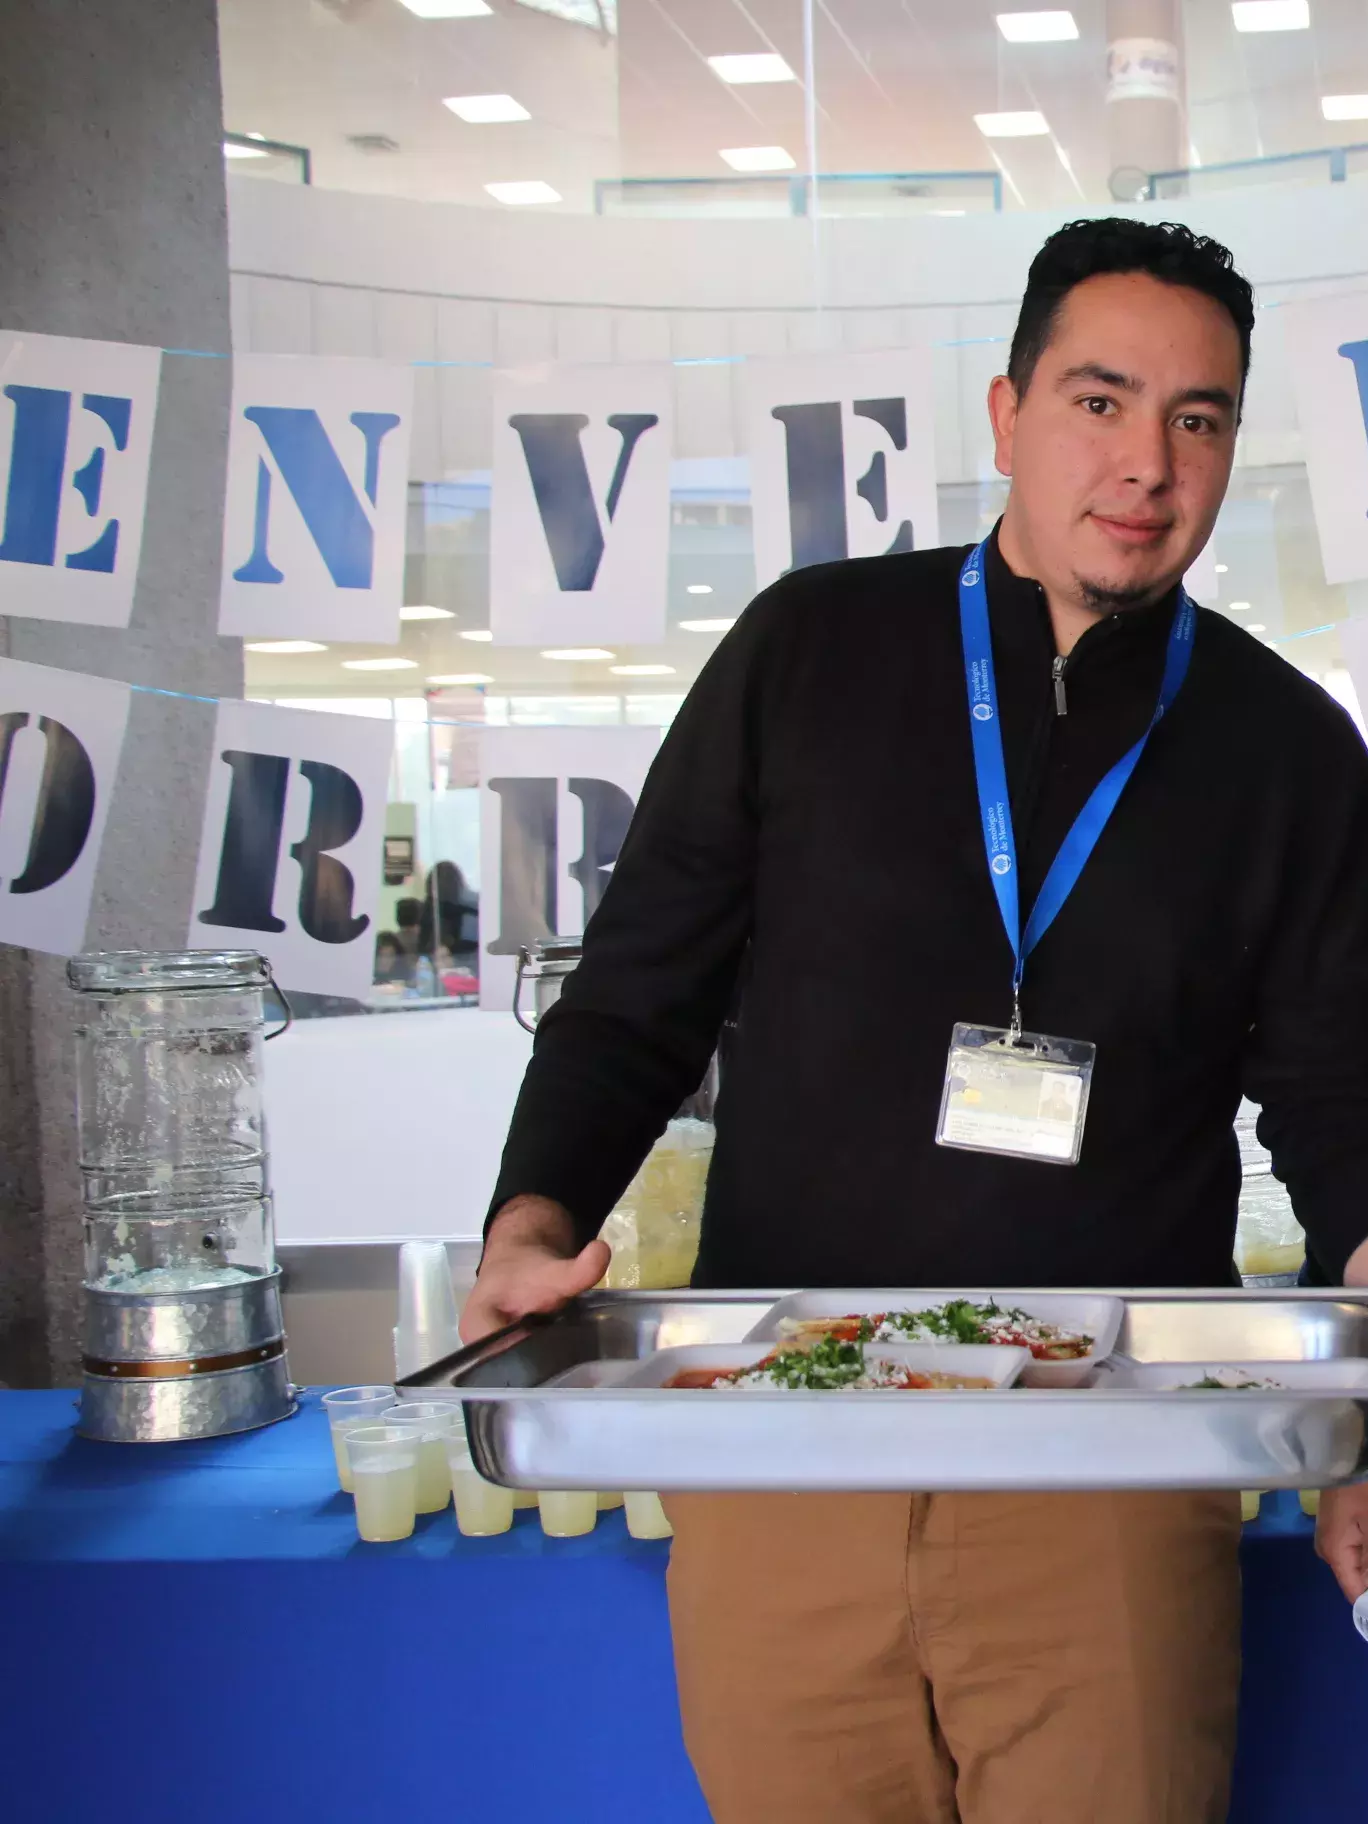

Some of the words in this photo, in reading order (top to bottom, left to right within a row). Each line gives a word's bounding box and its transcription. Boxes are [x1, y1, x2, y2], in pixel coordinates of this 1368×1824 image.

[980, 658, 991, 692] Monterrey
[987, 807, 1000, 853] Tecnológico
[997, 801, 1008, 840] Monterrey
